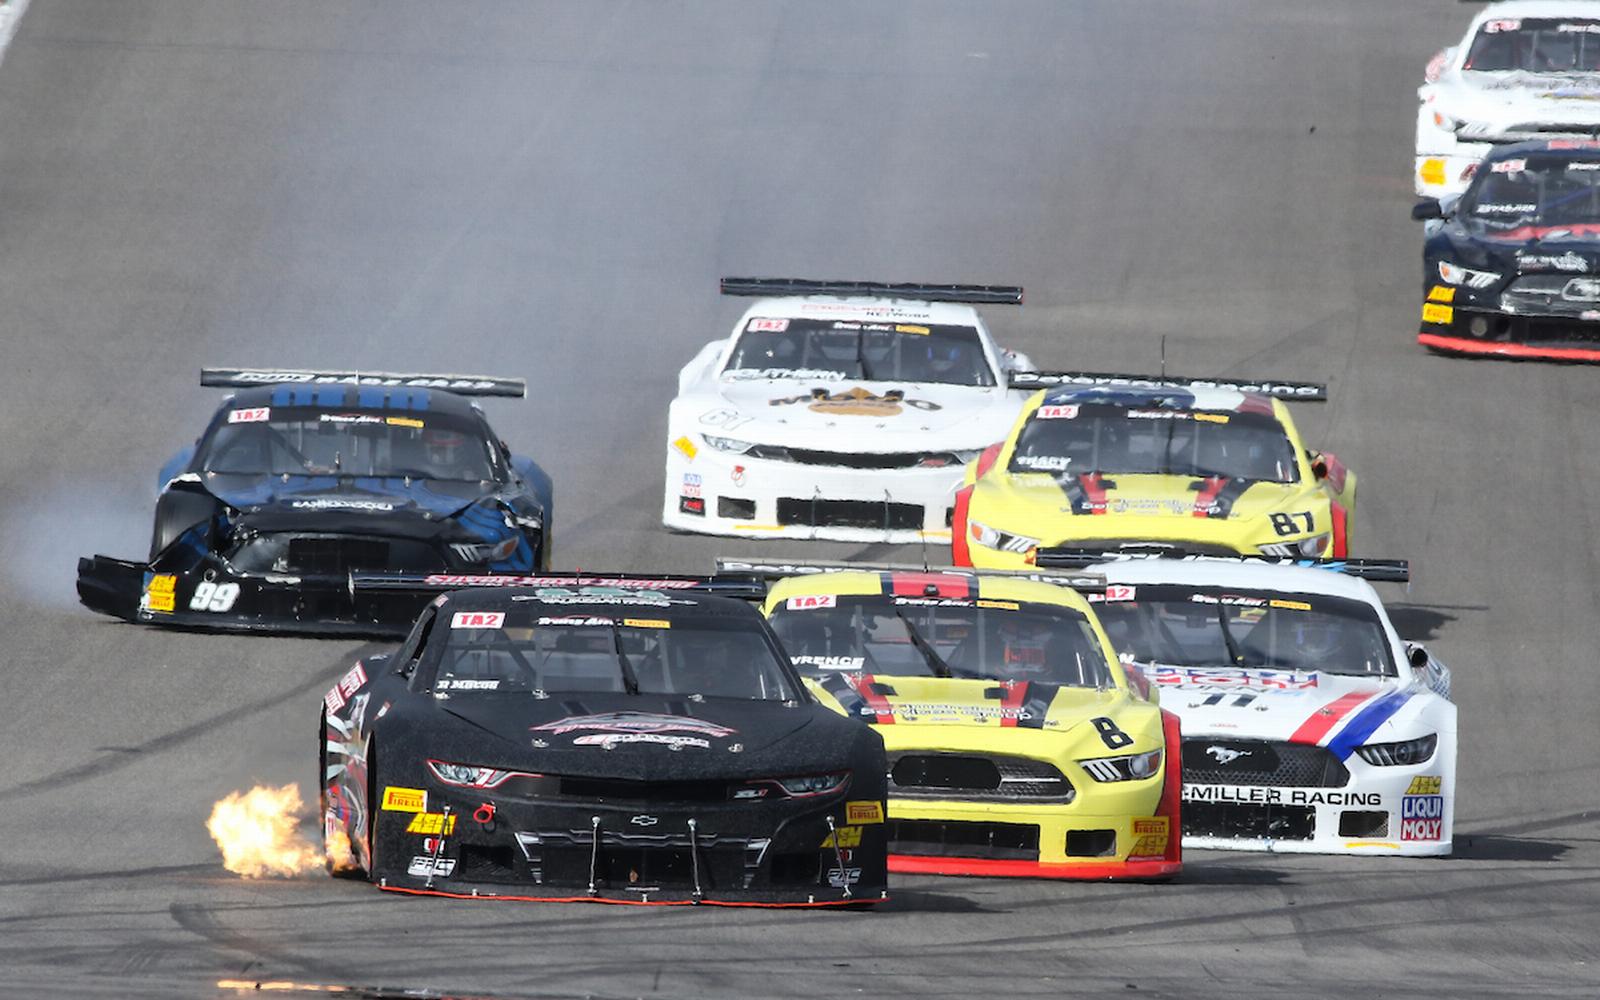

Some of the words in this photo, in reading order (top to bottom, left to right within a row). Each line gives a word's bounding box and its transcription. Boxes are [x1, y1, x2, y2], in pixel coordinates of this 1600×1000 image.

[756, 320, 783, 330] TA2
[236, 410, 266, 420] TA2
[1043, 407, 1073, 417] TA2
[1269, 511, 1314, 536] 87
[189, 581, 240, 612] 99
[1096, 587, 1131, 600] A2
[795, 596, 830, 608] TA2
[460, 614, 499, 627] TA2
[1090, 716, 1134, 750] 8
[387, 791, 424, 808] PIRELLI
[1292, 791, 1381, 806] RACING
[1404, 797, 1442, 818] LIQUI
[1403, 820, 1441, 840] MOLY
